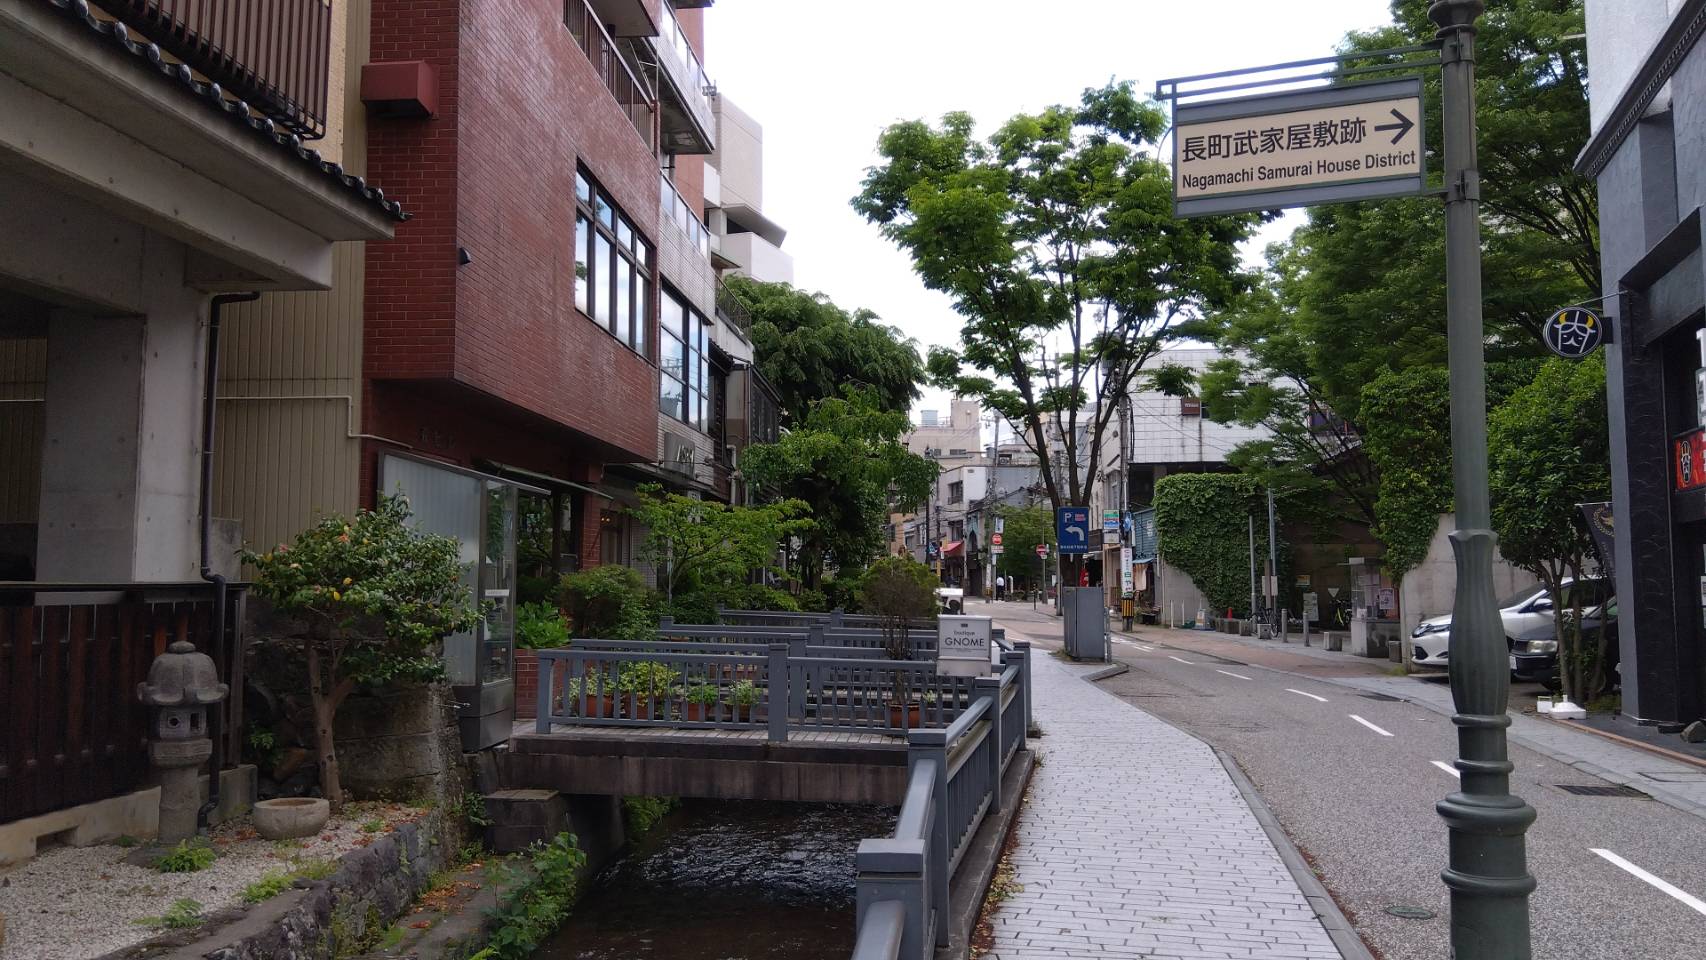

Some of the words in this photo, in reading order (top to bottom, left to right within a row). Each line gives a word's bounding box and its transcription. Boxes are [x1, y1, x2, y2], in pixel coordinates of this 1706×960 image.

[1182, 117, 1366, 162] 長町武家屋敷跡
[1182, 167, 1254, 190] Nagamachi
[1258, 160, 1313, 181] Samurai
[1317, 156, 1361, 175] House
[1365, 149, 1416, 170] District
[1064, 512, 1072, 523] P
[944, 637, 985, 647] GNOME
